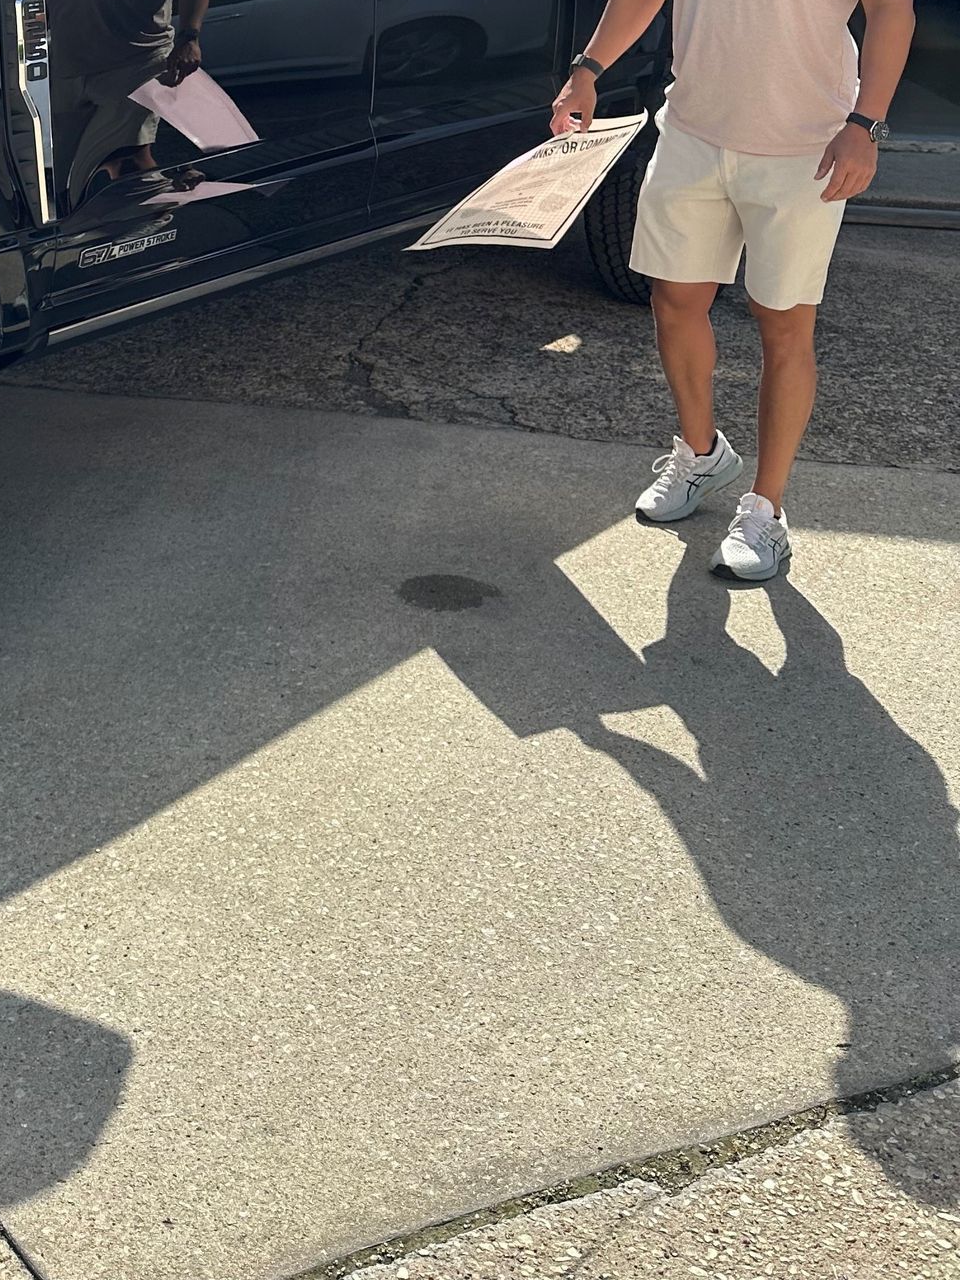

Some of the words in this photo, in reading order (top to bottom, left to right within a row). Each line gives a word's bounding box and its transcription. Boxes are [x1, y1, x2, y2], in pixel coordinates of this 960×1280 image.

[500, 220, 545, 230] PLEASURE
[499, 227, 518, 235] YOU
[119, 238, 146, 254] POWER
[146, 230, 176, 247] STROKE
